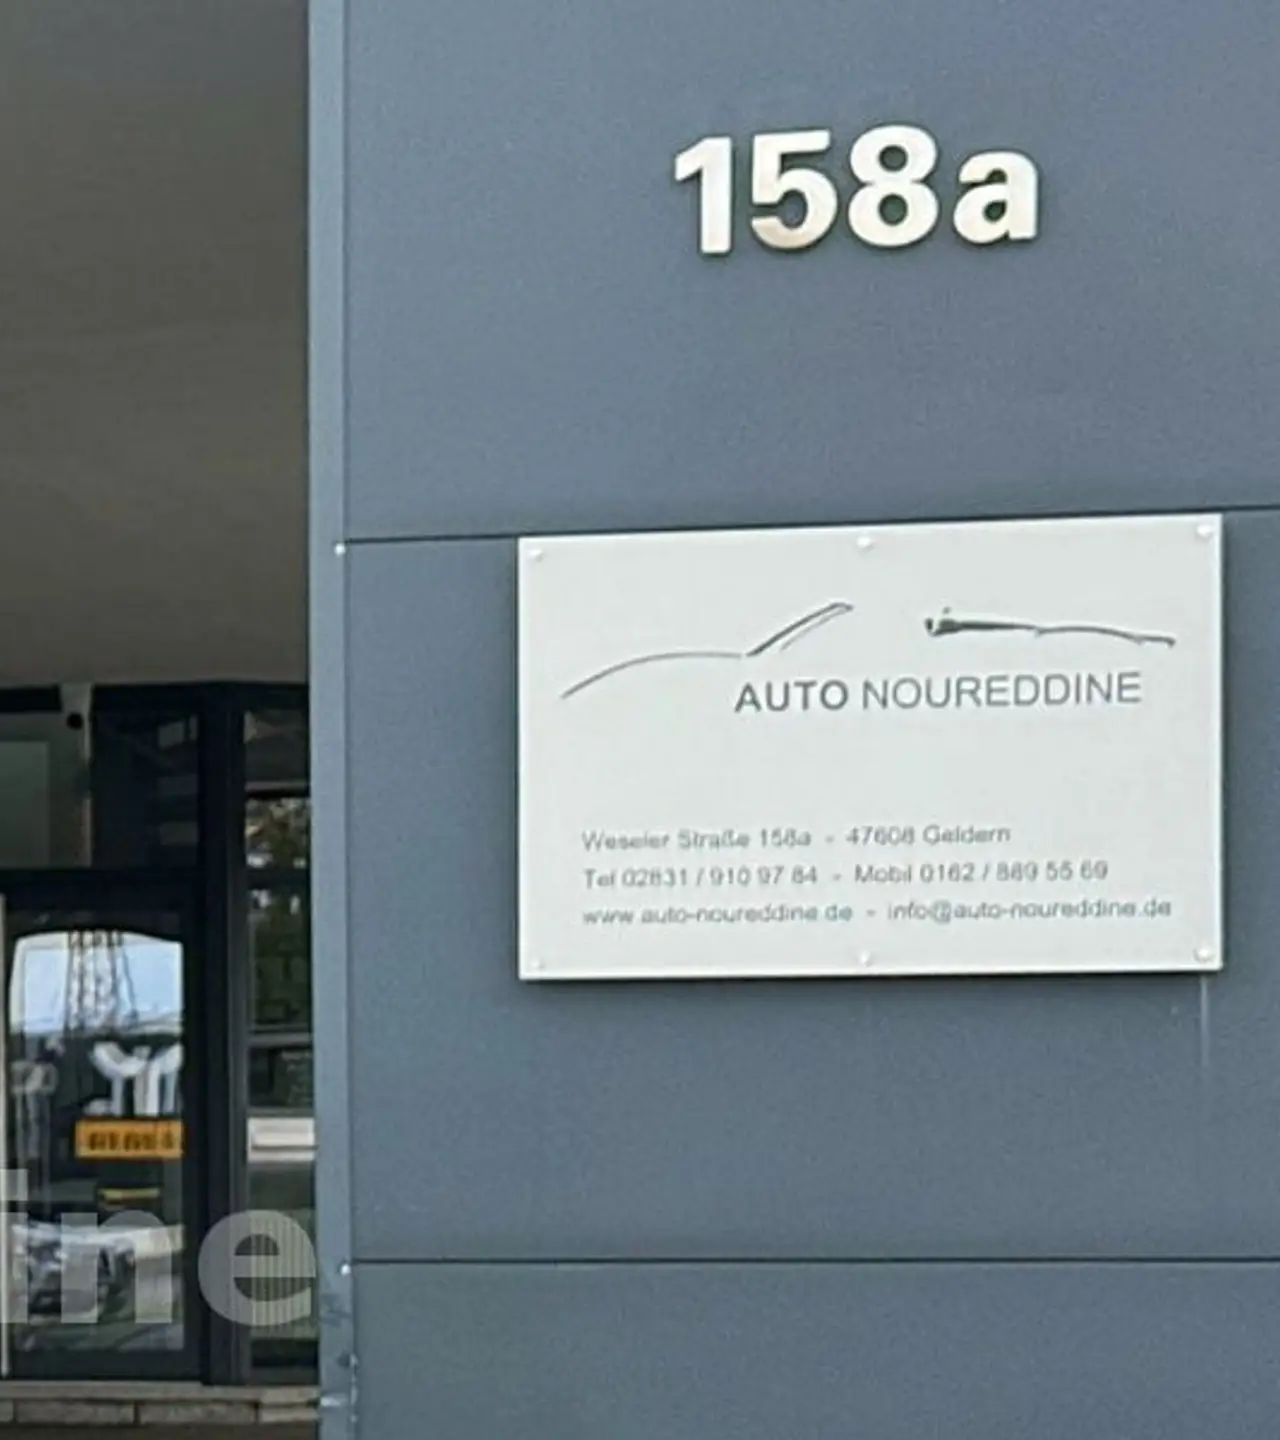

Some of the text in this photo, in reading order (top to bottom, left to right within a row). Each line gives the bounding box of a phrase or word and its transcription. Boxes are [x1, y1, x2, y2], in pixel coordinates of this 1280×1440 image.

[674, 124, 1039, 254] 158a
[734, 671, 1142, 713] AUTO NOUREDDINE
[581, 829, 670, 850] Weseler
[677, 828, 750, 850] Straße
[760, 827, 812, 848] 158a
[845, 825, 915, 845] 47608
[922, 823, 1011, 844] Geldern
[621, 867, 688, 888] 02831
[709, 866, 751, 887] 910
[757, 865, 784, 886] 97
[790, 864, 818, 885] 84
[854, 863, 913, 883] Mobil
[919, 863, 975, 883] 0162
